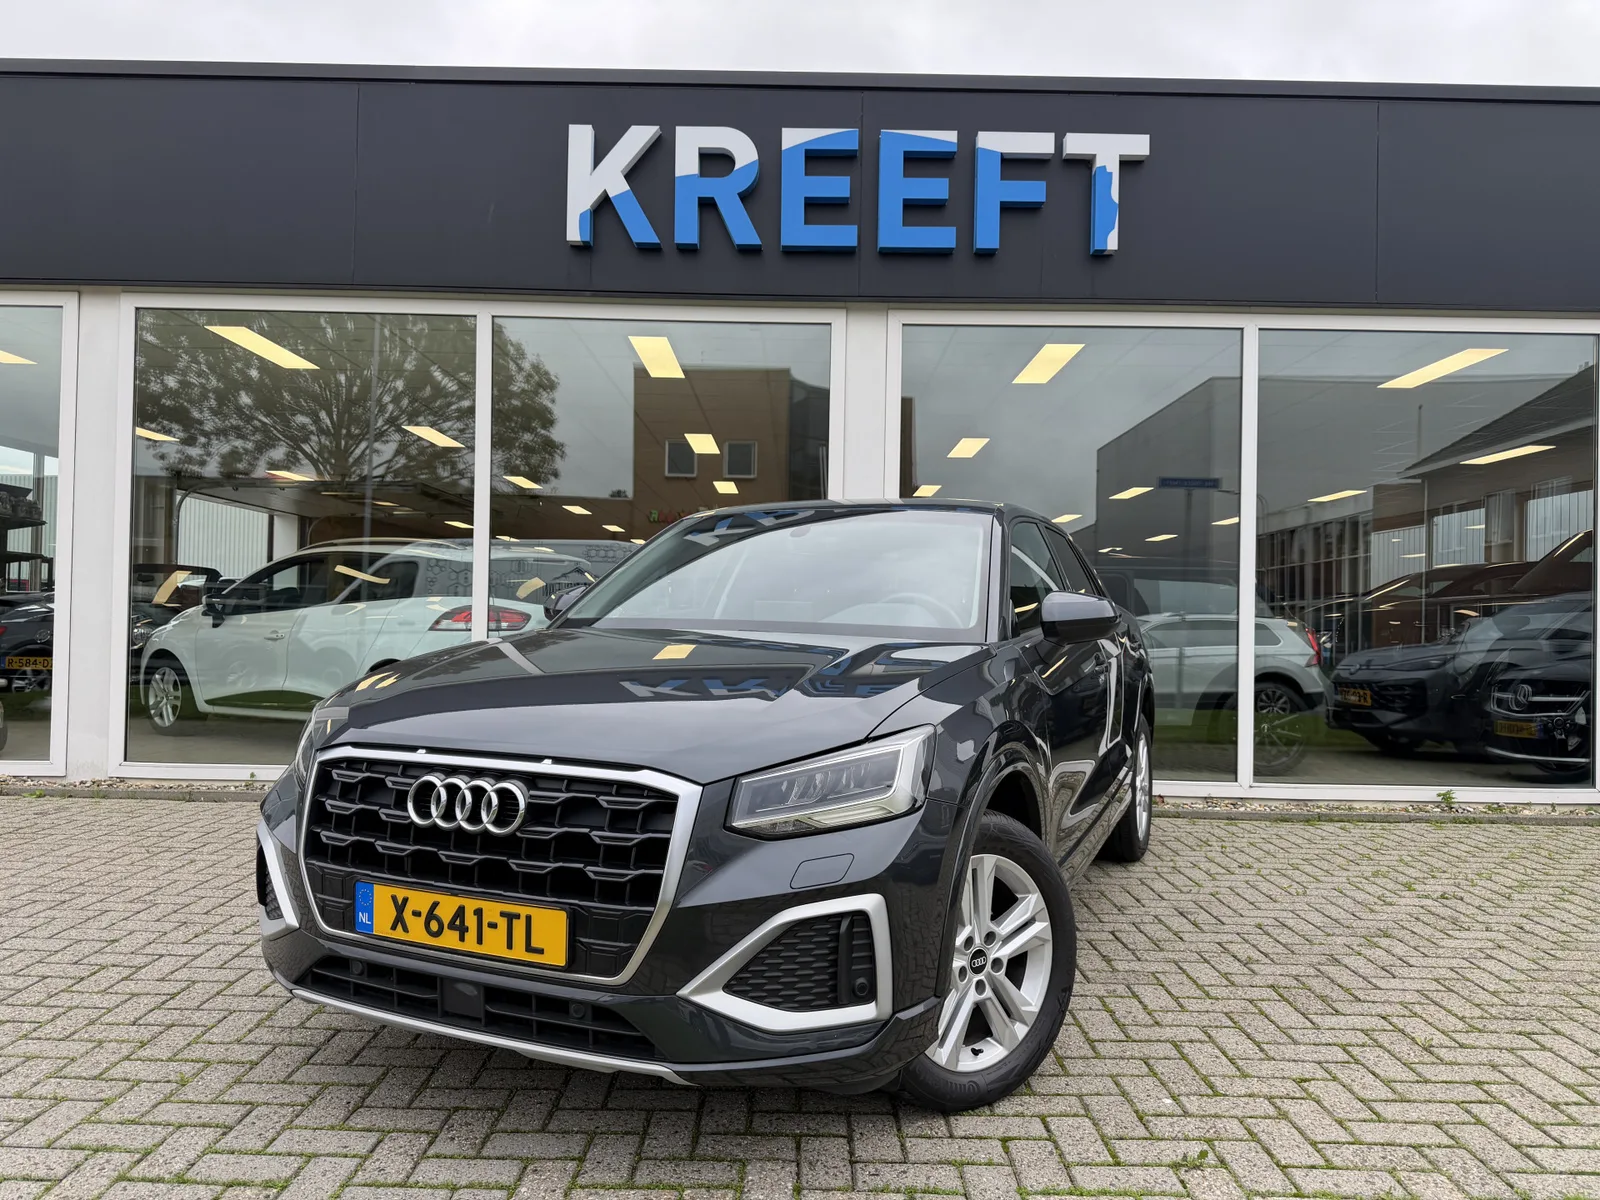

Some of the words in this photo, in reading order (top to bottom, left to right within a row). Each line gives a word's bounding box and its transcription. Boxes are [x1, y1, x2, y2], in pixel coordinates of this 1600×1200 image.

[566, 124, 1150, 255] KREEFT
[7, 658, 53, 668] R-584-D
[358, 911, 371, 925] NL
[390, 894, 545, 955] X-641-TL
